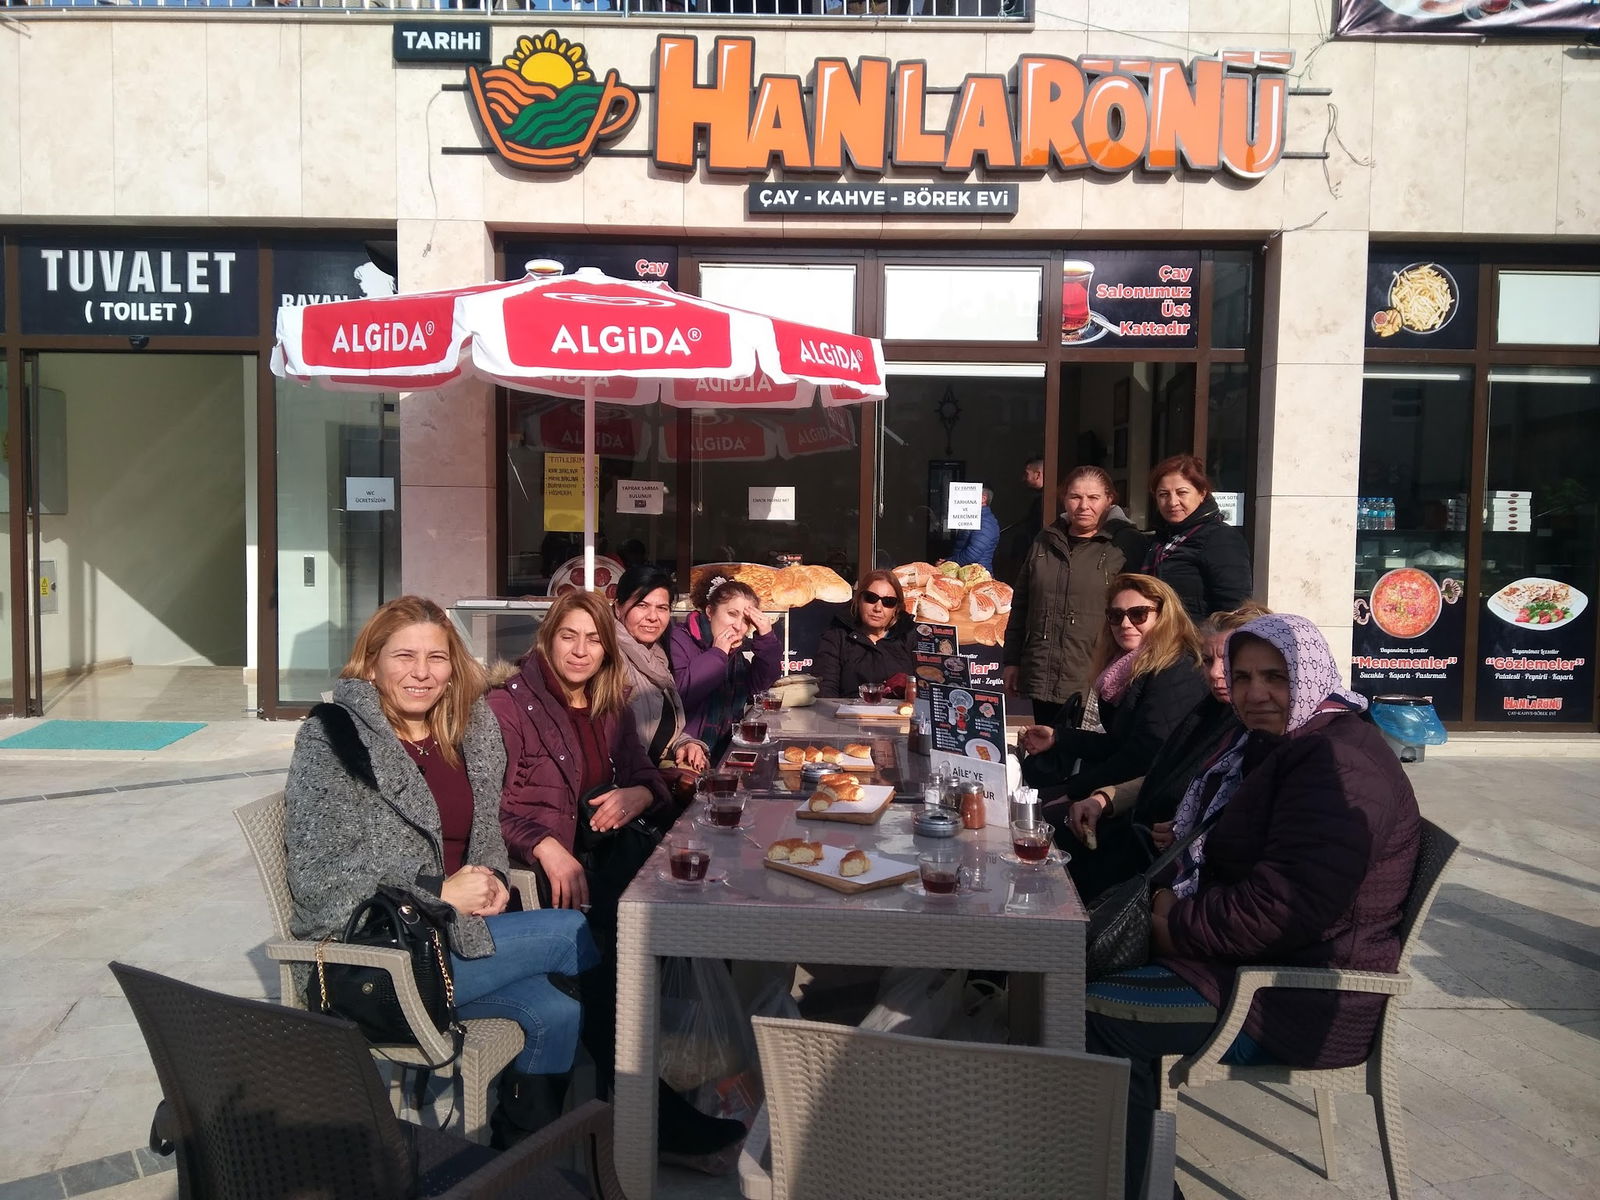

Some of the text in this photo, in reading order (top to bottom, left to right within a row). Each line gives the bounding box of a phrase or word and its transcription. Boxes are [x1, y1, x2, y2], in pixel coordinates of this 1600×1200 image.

[759, 190, 799, 207] ÇAY
[817, 191, 885, 206] KAHVE
[903, 187, 971, 206] BÖREK
[41, 250, 236, 293] TUVALET
[635, 259, 669, 277] Çay
[1159, 265, 1192, 282] Çay
[1096, 284, 1191, 298] Salonumuz
[100, 302, 177, 321] TOILET
[1161, 300, 1190, 317] Üst
[1120, 321, 1190, 336] Kattadır
[973, 772, 984, 781] YE
